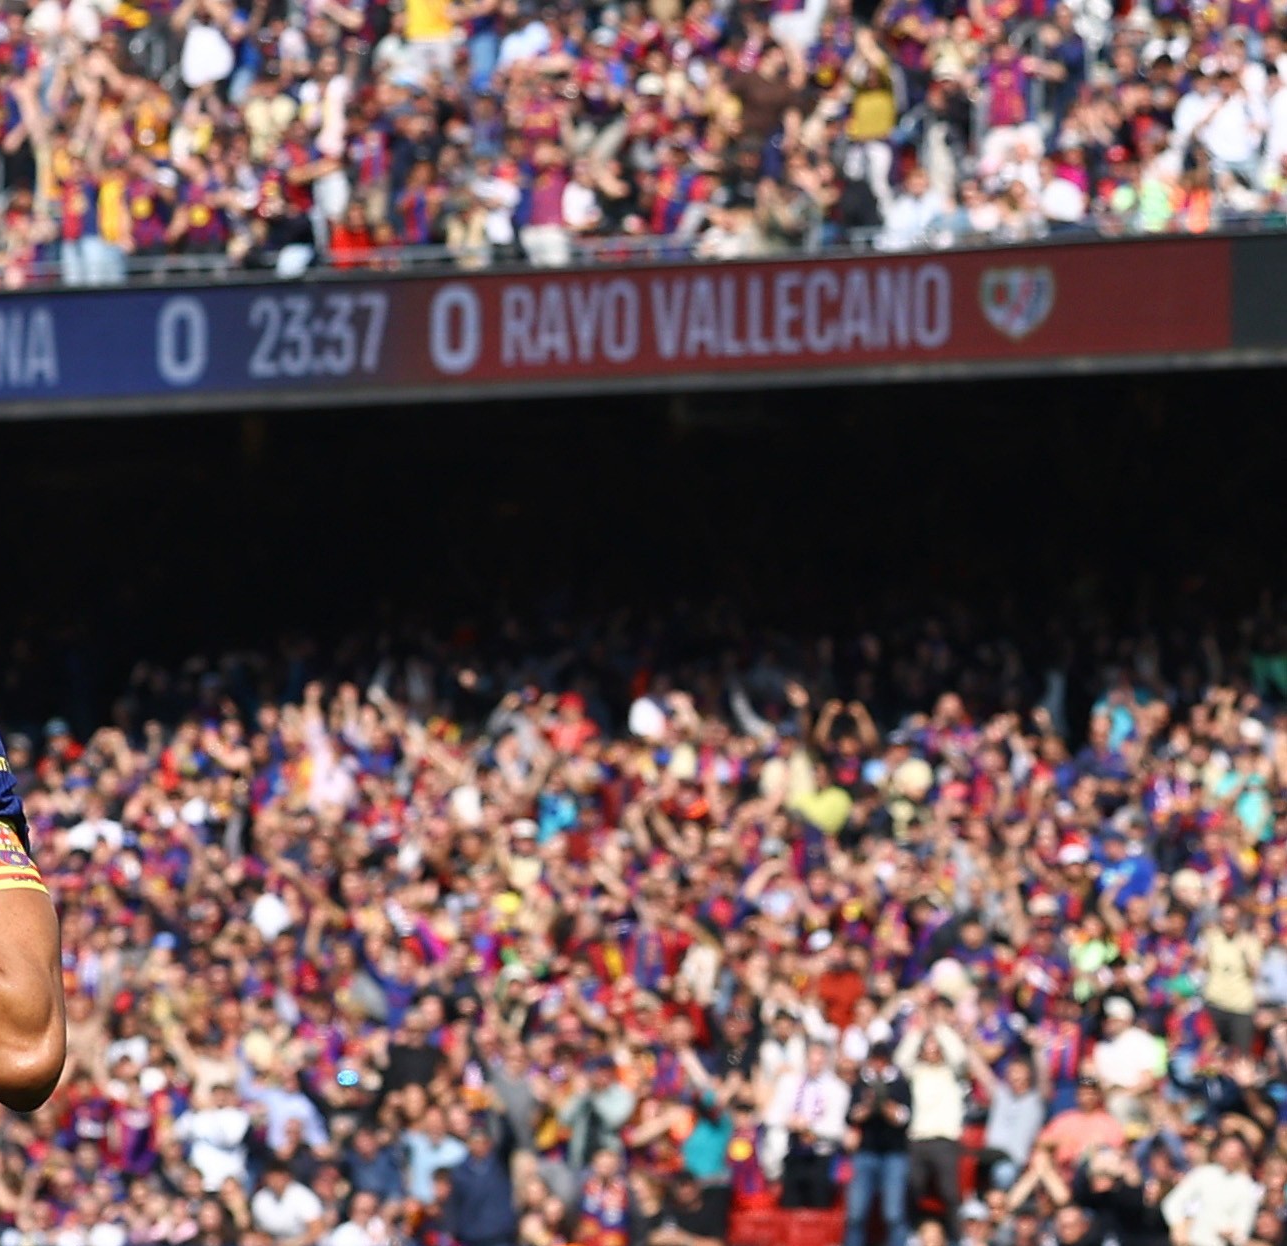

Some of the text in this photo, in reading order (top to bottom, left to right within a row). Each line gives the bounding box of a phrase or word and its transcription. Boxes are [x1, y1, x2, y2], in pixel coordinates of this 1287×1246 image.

[155, 298, 209, 387] 0
[247, 290, 390, 380] 23:37
[429, 281, 481, 375] 0
[501, 276, 640, 367] RAYO
[649, 263, 953, 360] VALLECANO
